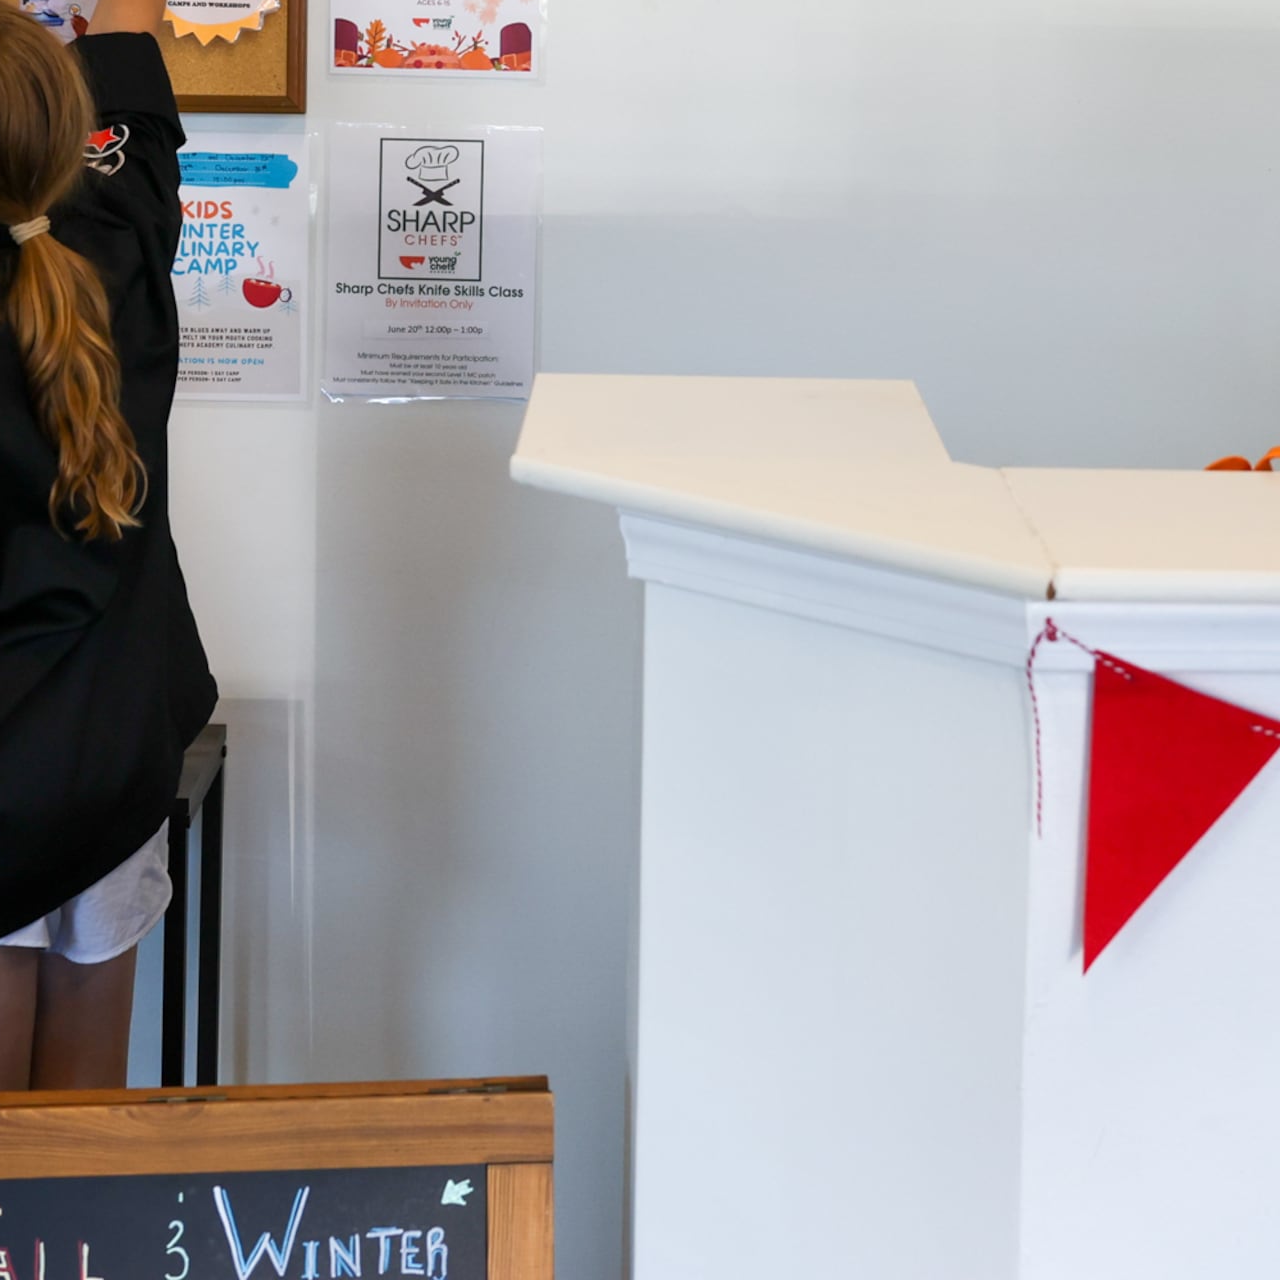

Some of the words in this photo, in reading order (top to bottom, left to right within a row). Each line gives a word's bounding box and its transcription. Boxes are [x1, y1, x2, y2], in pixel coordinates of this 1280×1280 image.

[180, 200, 233, 219] KIDS
[387, 209, 476, 233] SHARP
[182, 223, 245, 239] INTER
[181, 240, 260, 258] LINARY
[171, 258, 237, 276] CAMP
[428, 256, 457, 266] young
[430, 262, 456, 271] chefs
[336, 282, 374, 296] Sharp
[376, 282, 415, 296] Chefs
[418, 284, 451, 296] Knife
[454, 284, 485, 298] Skills
[488, 286, 524, 298] Class
[385, 298, 398, 308] By
[400, 298, 447, 309] Invitation
[450, 299, 474, 310] Only
[388, 326, 406, 334] June
[408, 325, 424, 334] 20th
[425, 326, 452, 335] 12:00p
[461, 326, 483, 335] 1:00p
[357, 352, 390, 360] Minimum
[391, 352, 440, 362] Requirements
